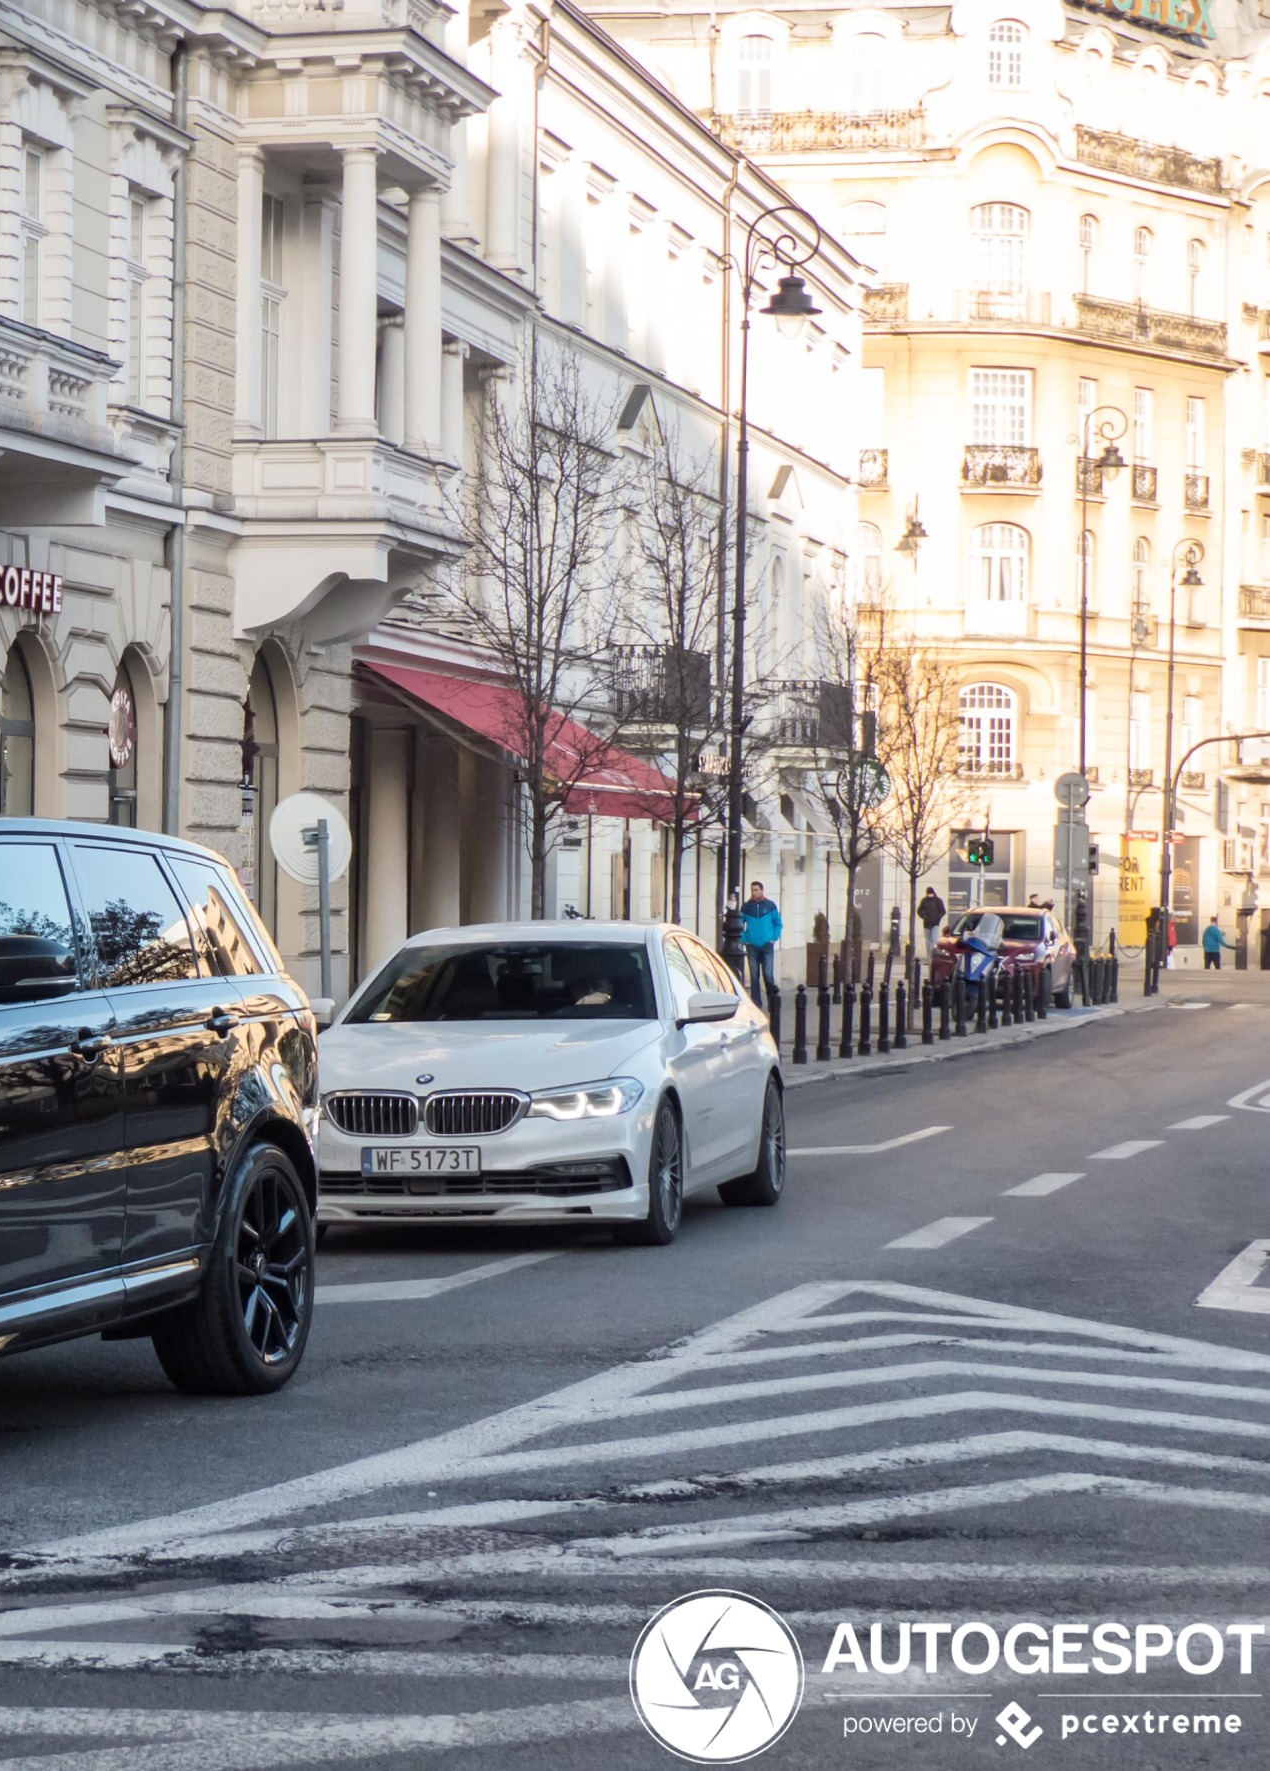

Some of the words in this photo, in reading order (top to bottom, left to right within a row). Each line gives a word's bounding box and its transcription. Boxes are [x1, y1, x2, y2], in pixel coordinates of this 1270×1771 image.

[112, 691, 131, 715] COSTA
[110, 738, 132, 766] COFFEE
[376, 1150, 402, 1171] WF
[410, 1150, 474, 1170] 5173T
